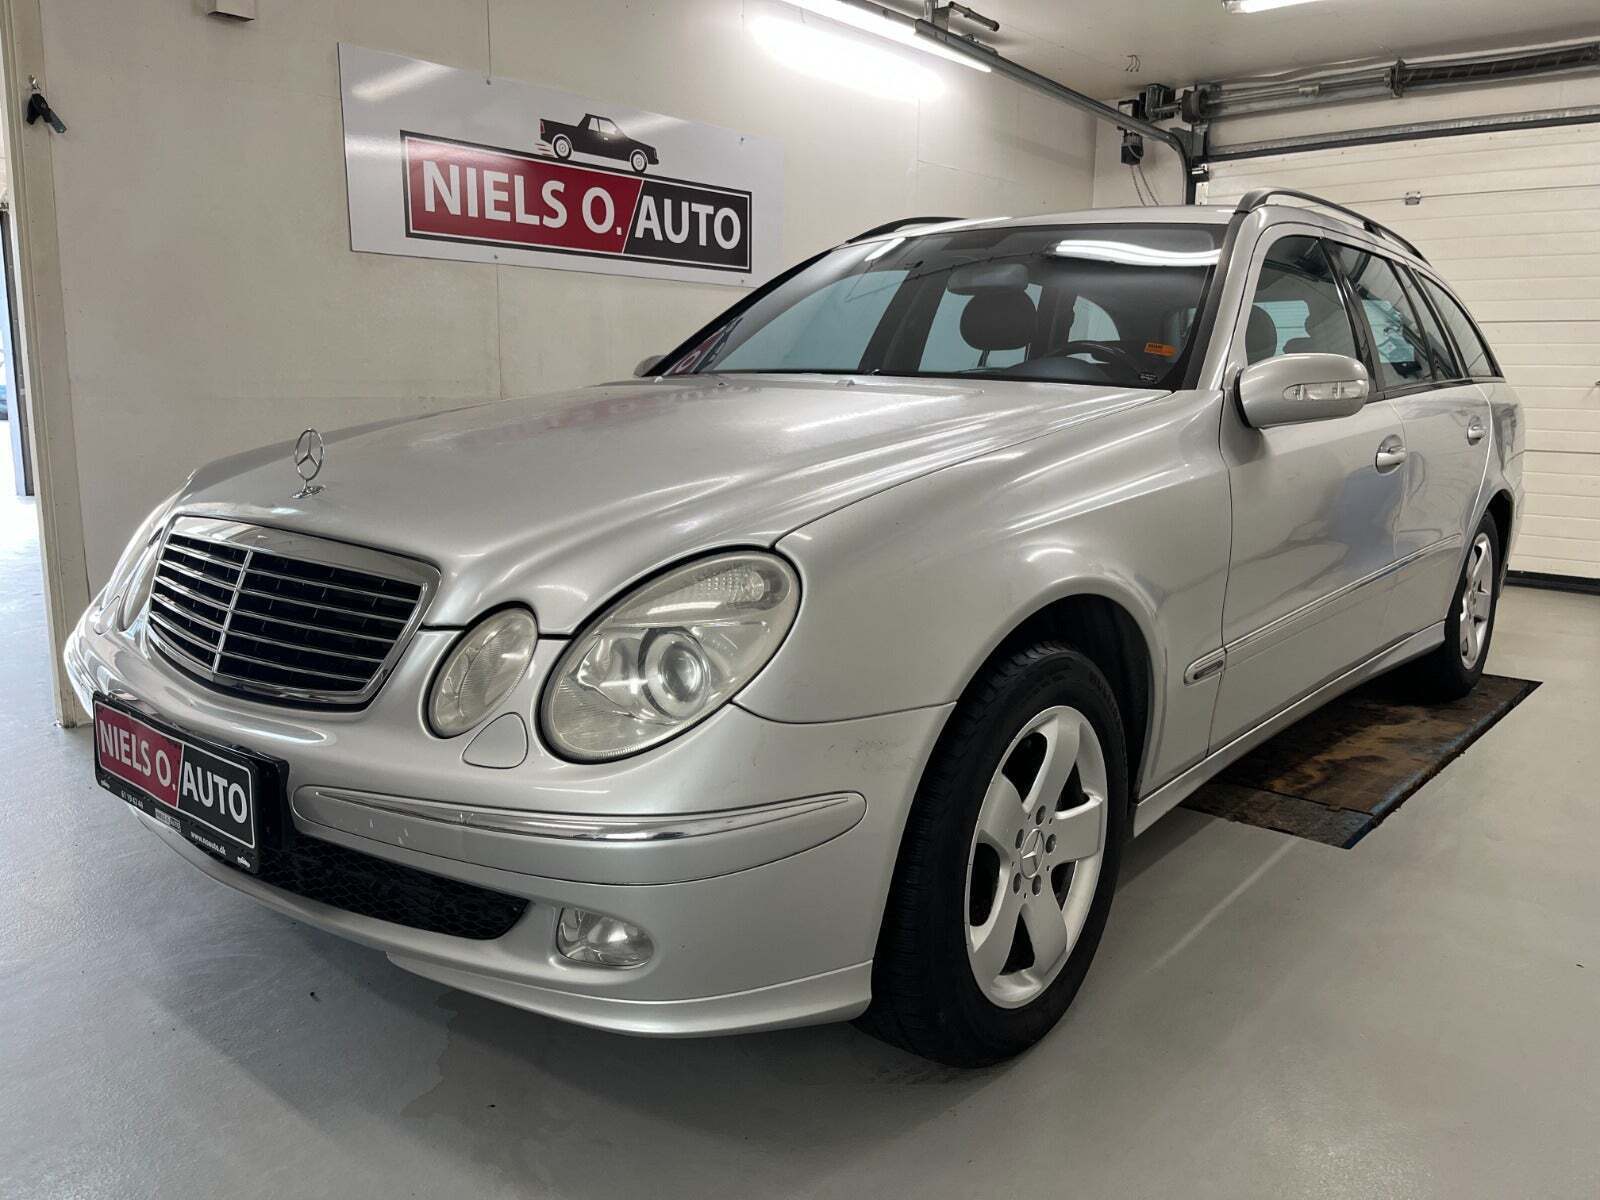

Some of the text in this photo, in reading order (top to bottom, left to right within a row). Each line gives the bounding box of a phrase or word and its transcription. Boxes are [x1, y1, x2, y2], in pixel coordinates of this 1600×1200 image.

[423, 159, 741, 249] NIELS O. AUTO
[99, 720, 151, 777] NIELS
[155, 749, 176, 791] O.
[182, 762, 247, 823] AUTO
